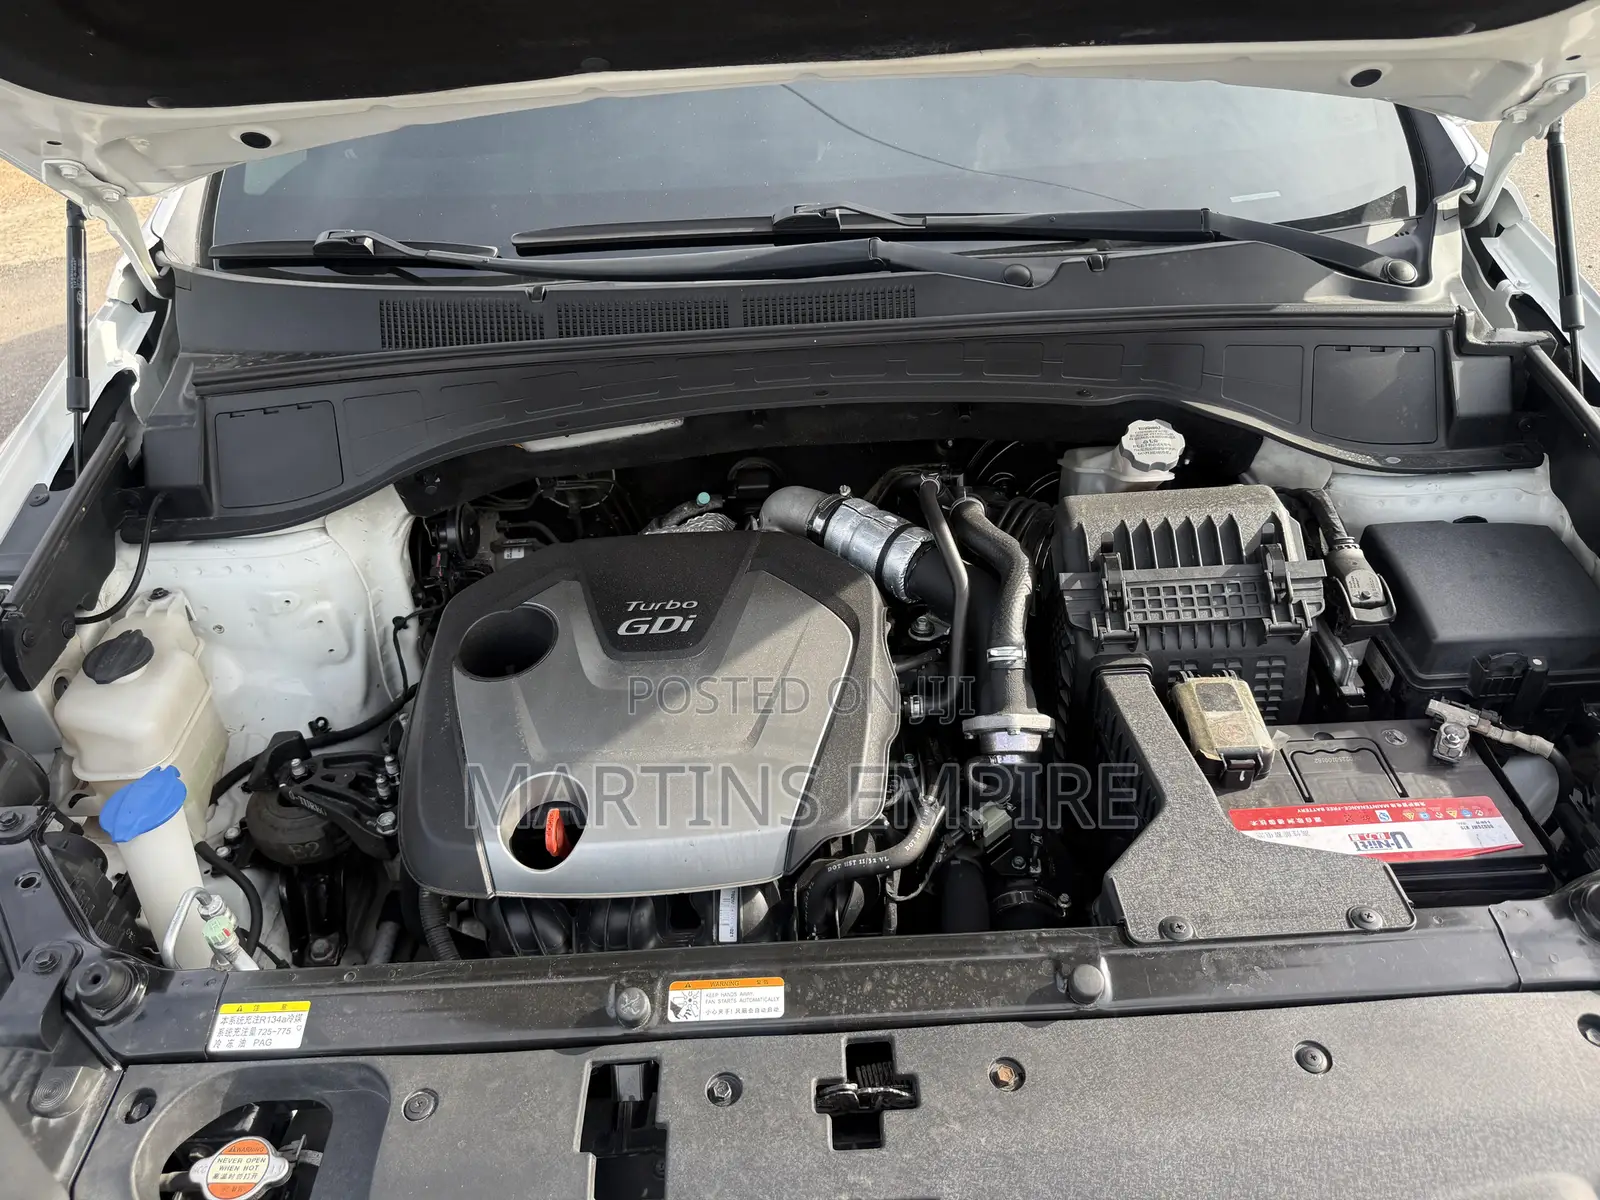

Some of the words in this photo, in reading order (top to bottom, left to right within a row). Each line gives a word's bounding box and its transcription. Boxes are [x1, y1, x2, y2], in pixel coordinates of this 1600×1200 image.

[626, 600, 698, 612] Turbo
[617, 614, 697, 635] GDi
[827, 863, 842, 872] DOT
[252, 1038, 272, 1047] PAG
